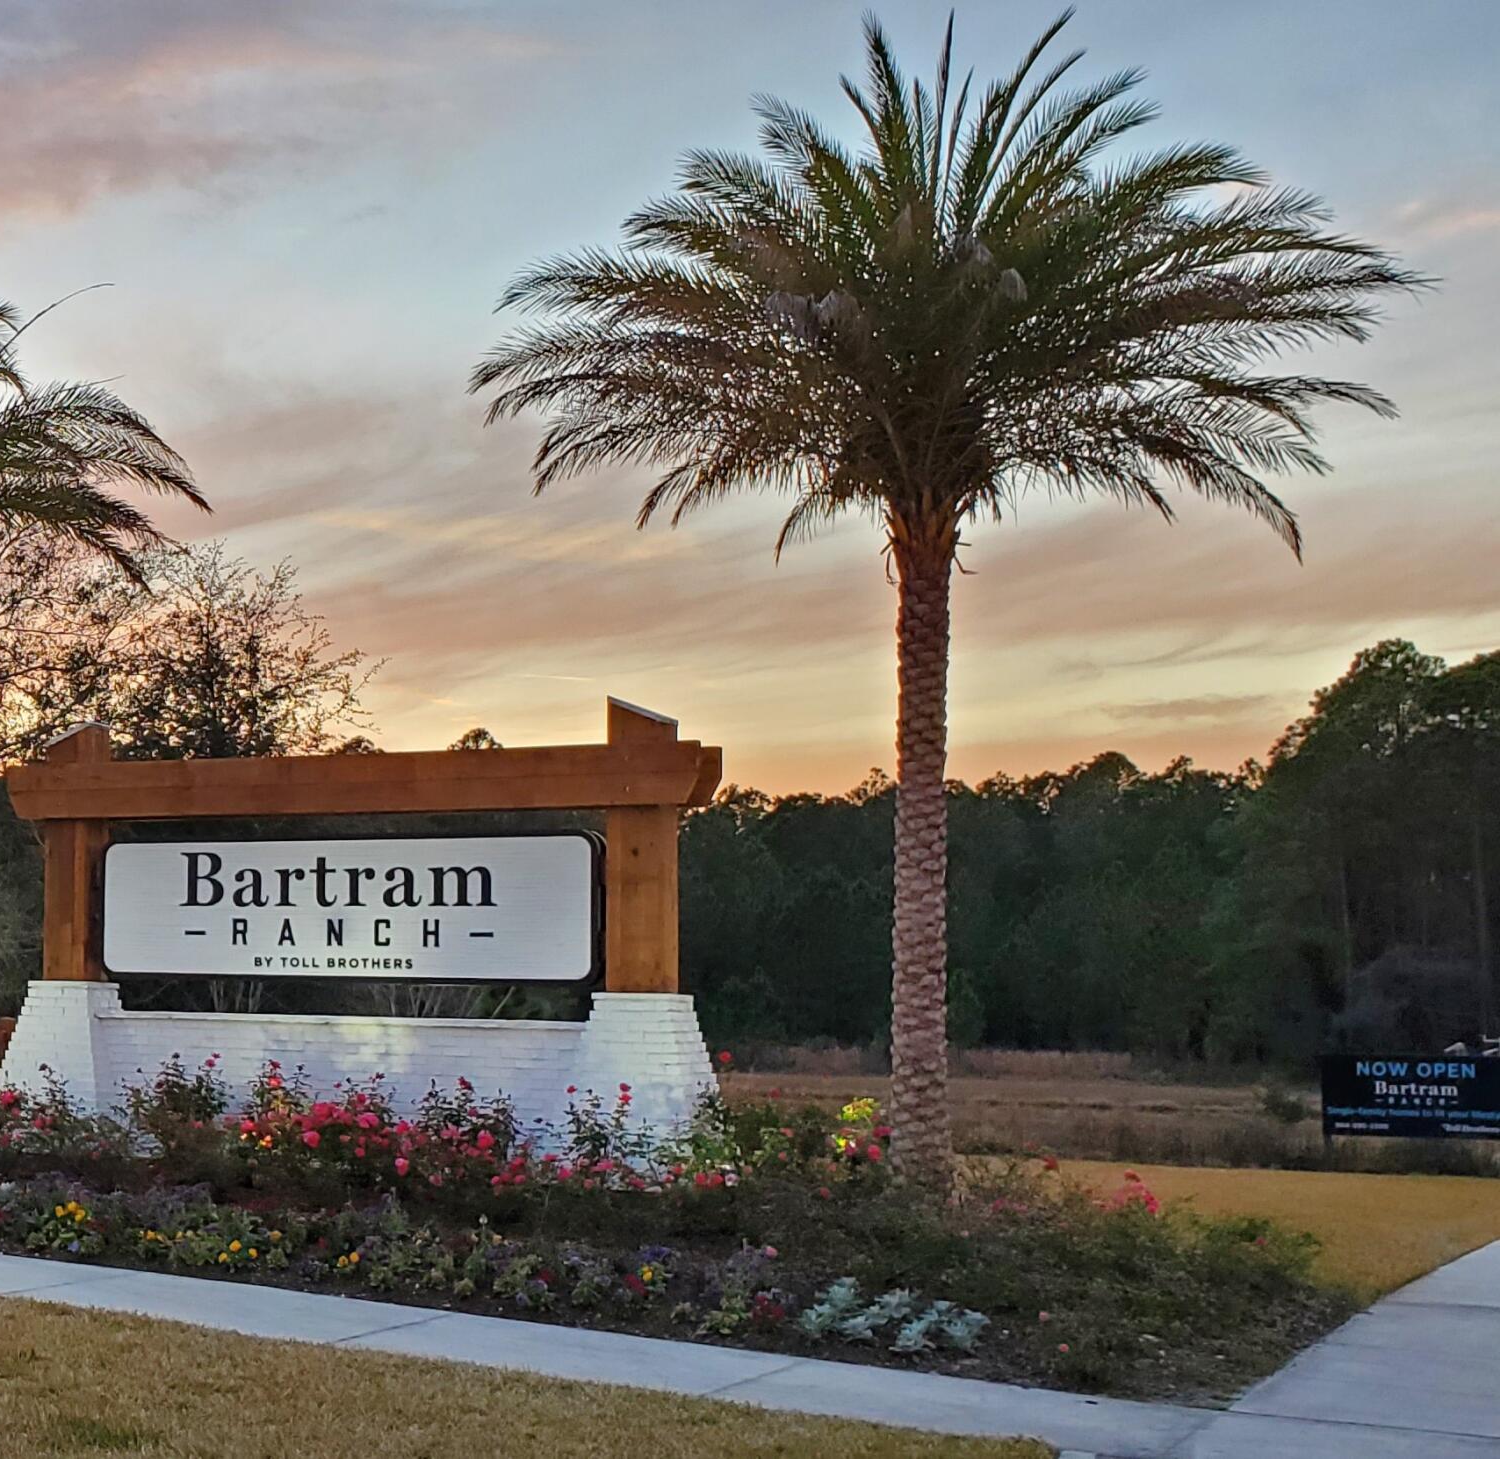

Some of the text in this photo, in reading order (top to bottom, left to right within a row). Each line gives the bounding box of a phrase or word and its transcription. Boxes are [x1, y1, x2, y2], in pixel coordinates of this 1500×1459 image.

[179, 851, 498, 908] Bartram
[231, 918, 441, 948] RANCH
[254, 956, 414, 970] BY TOLL BROTHERS
[1356, 1061, 1476, 1079] NOW OPEN
[1373, 1080, 1459, 1097] Bartram
